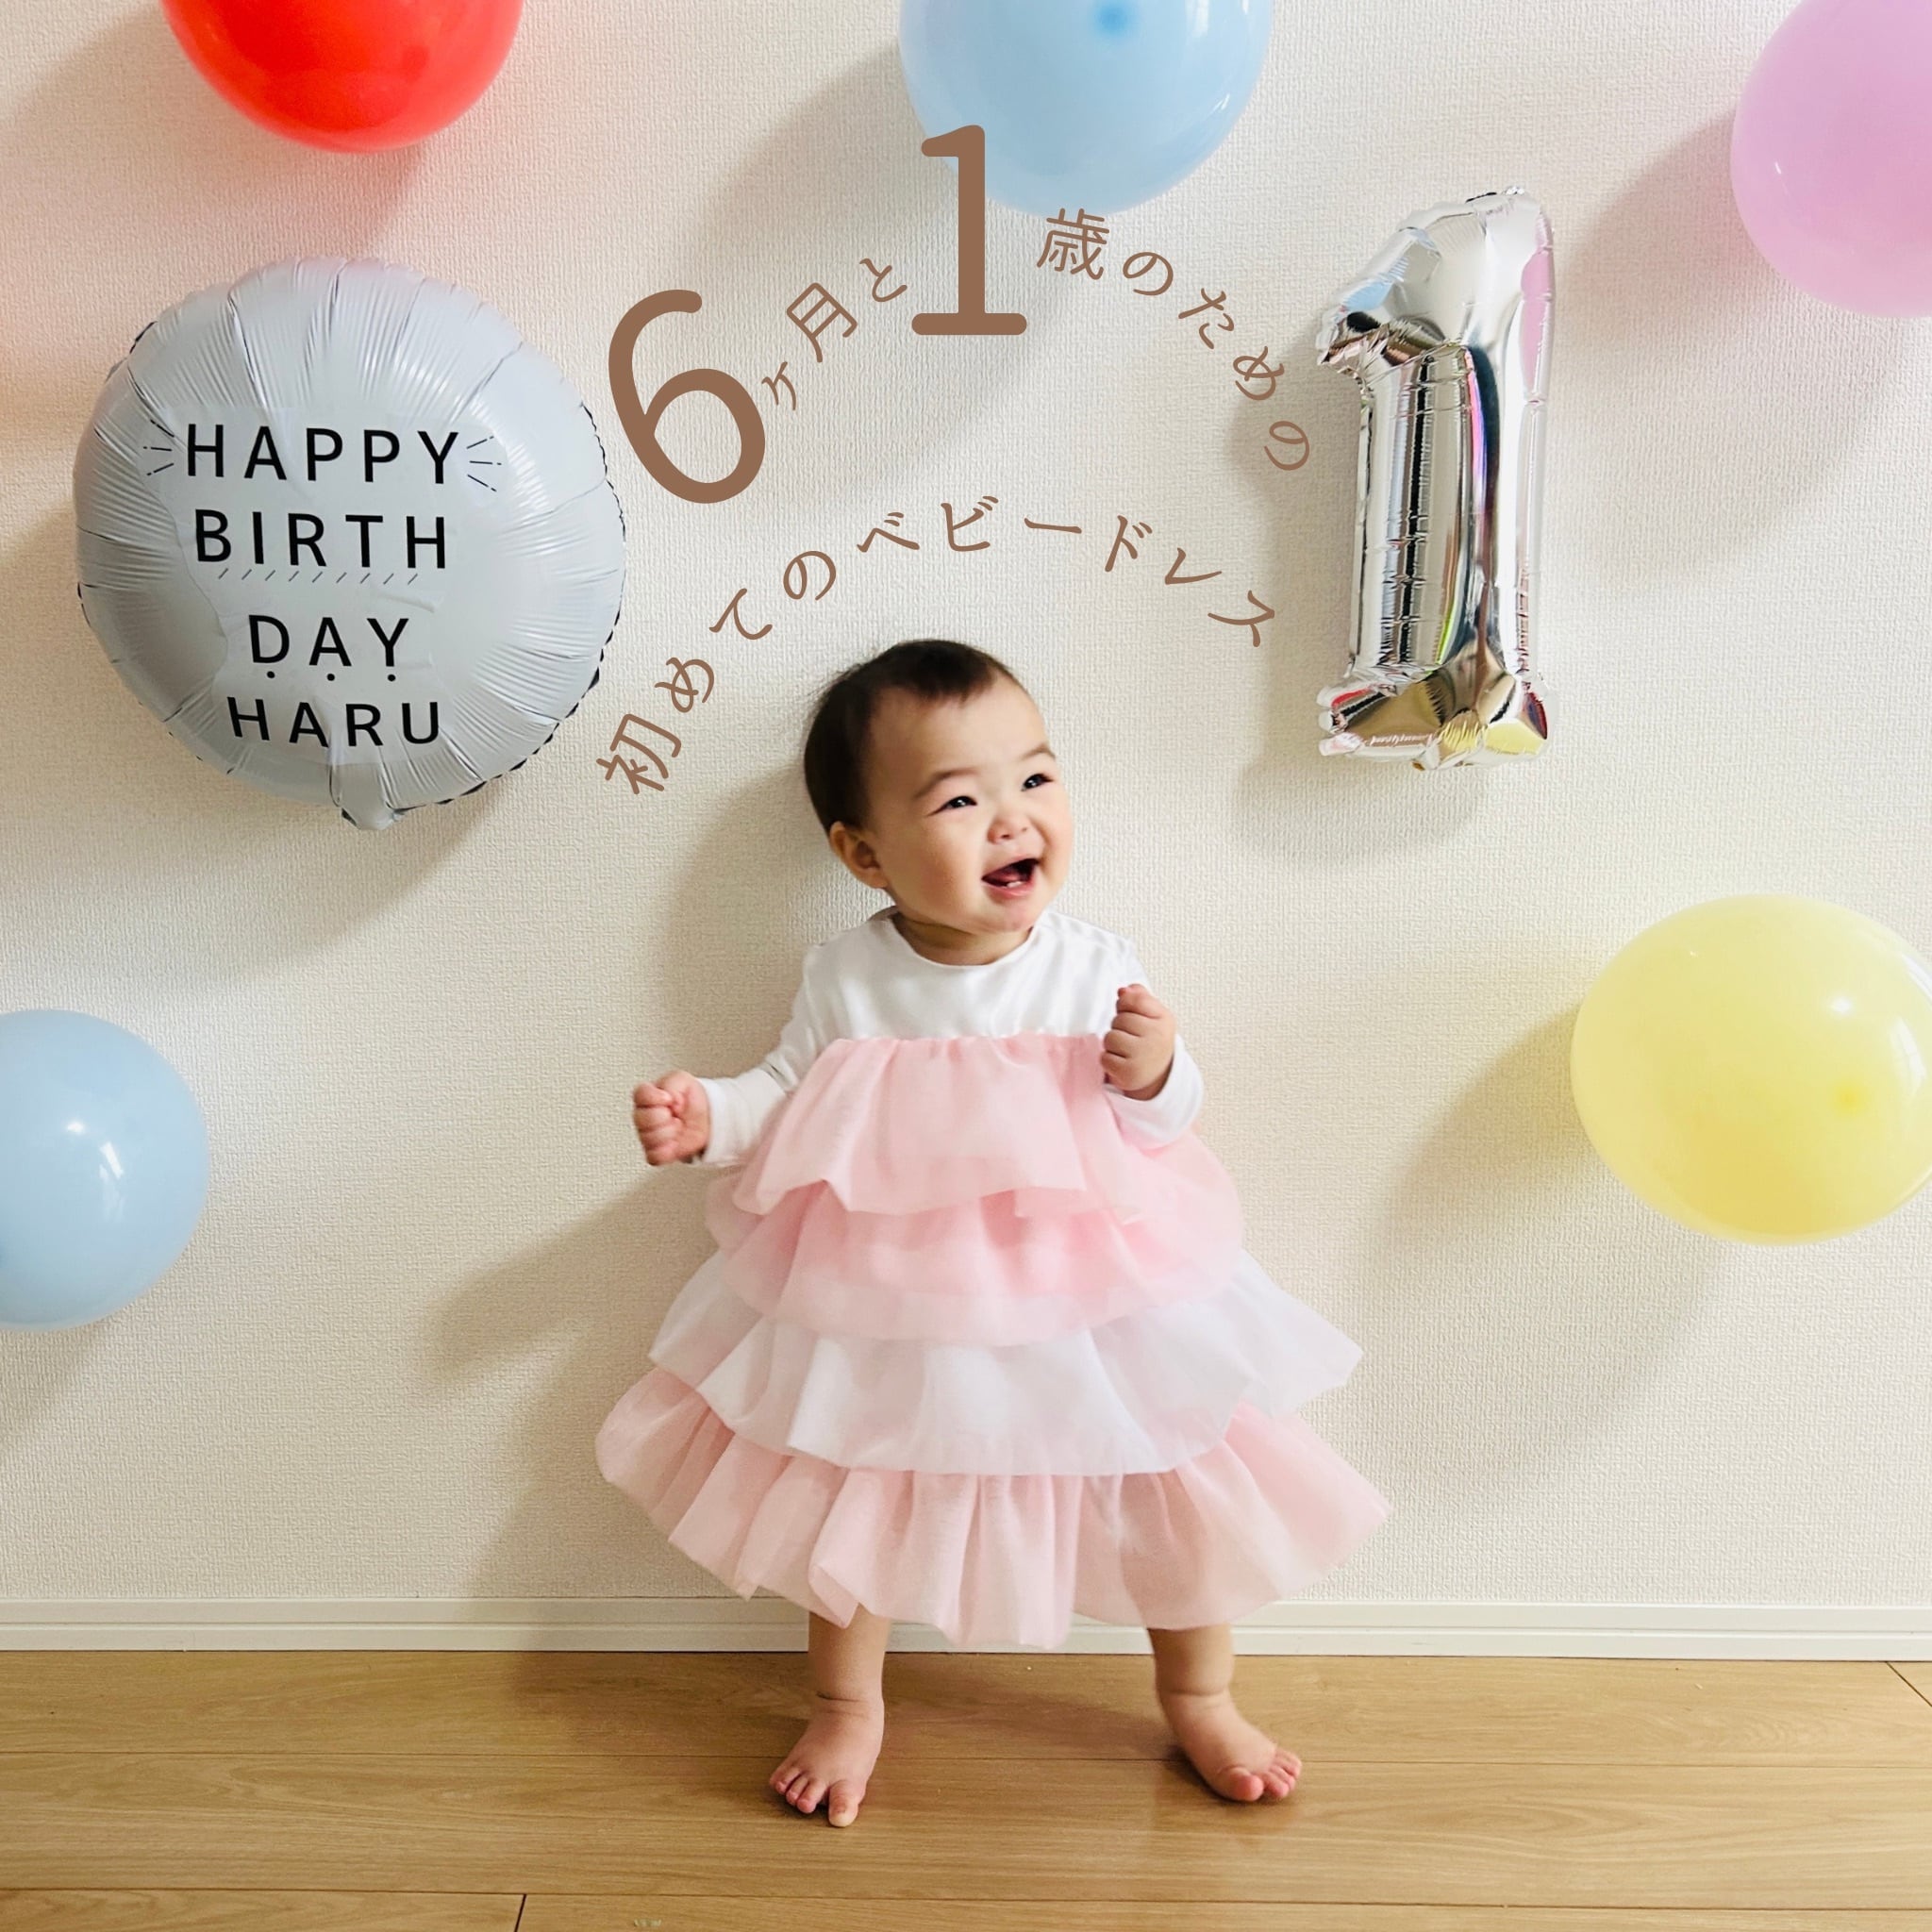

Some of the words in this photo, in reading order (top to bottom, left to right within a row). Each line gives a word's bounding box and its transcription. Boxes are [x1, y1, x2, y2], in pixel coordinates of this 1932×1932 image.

[186, 423, 459, 485] HAPPY
[1317, 187, 1557, 771] 1
[193, 508, 446, 570] BIRTH
[248, 614, 410, 668] DAY
[225, 695, 440, 748] HARU
